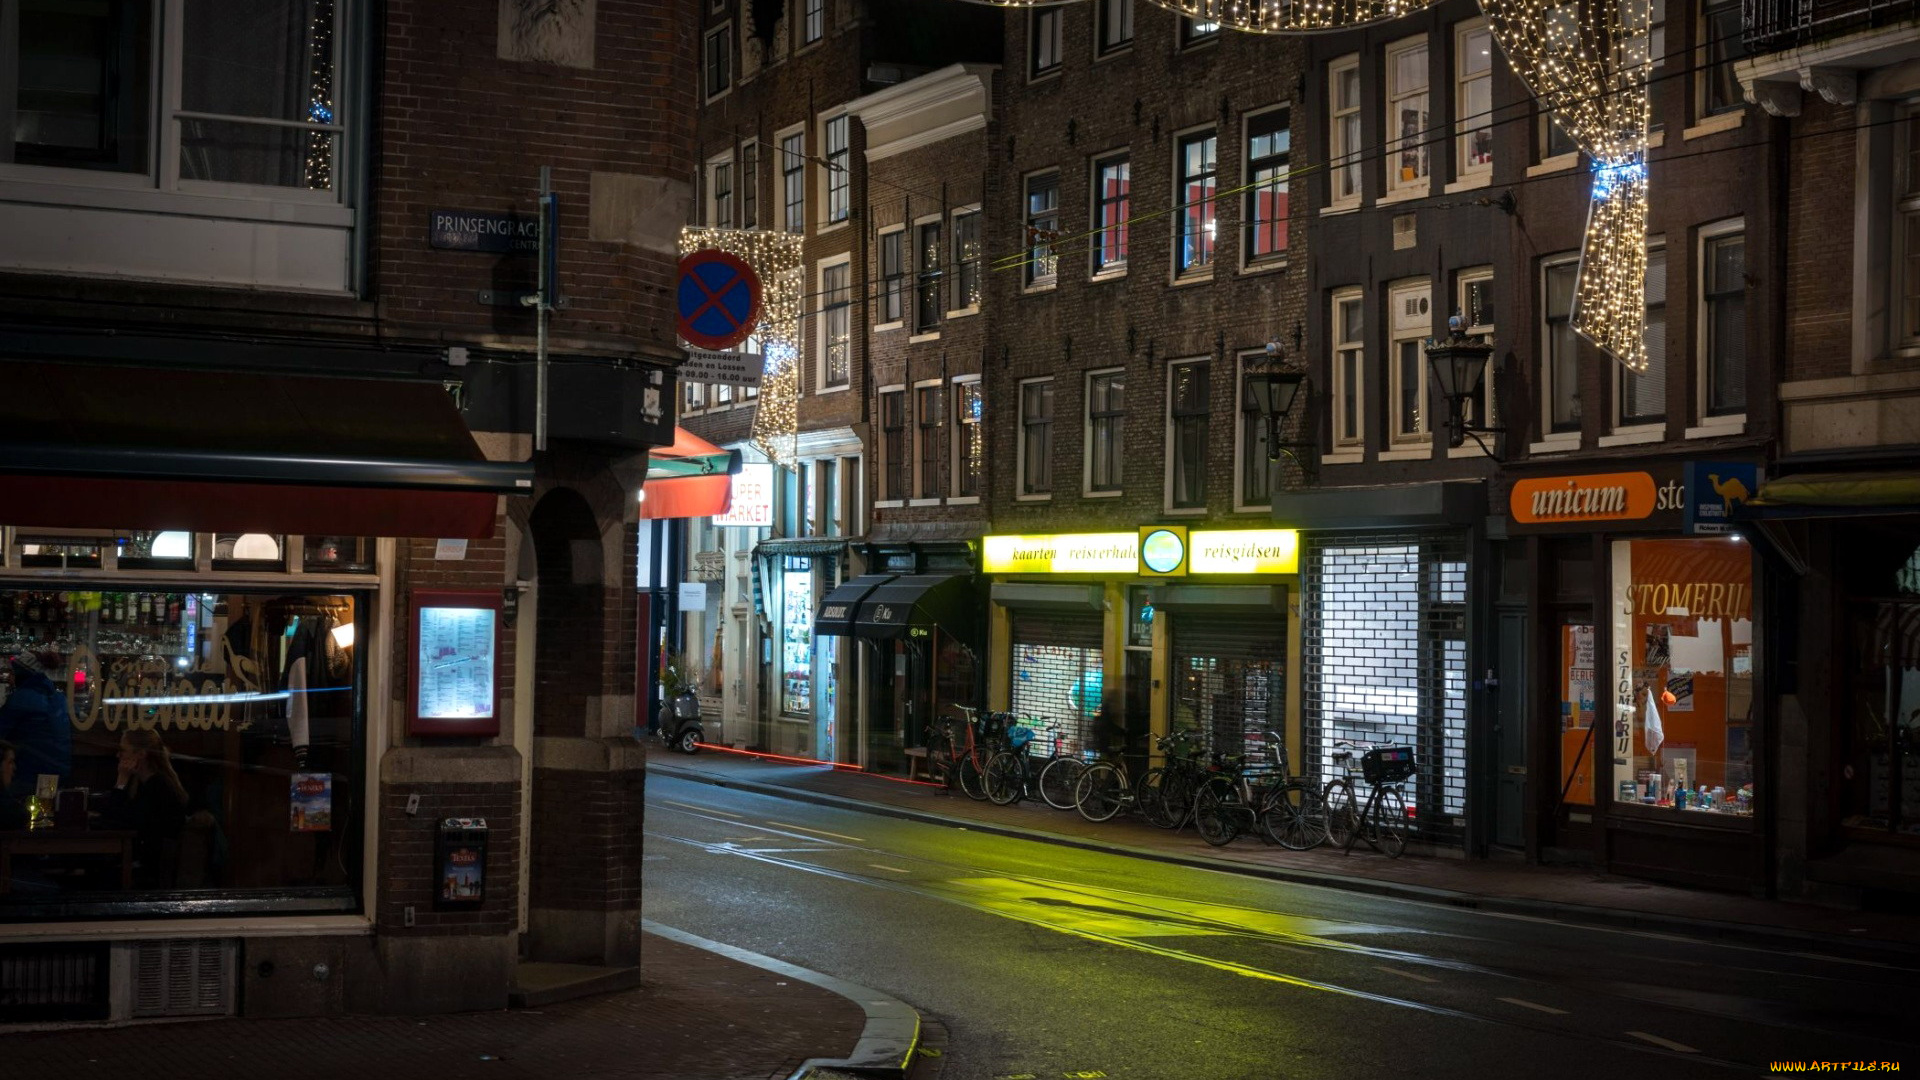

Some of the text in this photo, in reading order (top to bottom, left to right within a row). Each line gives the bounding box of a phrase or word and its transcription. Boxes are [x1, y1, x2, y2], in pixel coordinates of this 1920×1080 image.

[437, 215, 541, 238] PRINSENGRACH
[510, 239, 541, 251] CENTR
[690, 351, 741, 361] itgezonderd
[718, 373, 741, 381] 16.00
[743, 375, 757, 383] uur
[732, 483, 762, 500] UPER
[1531, 478, 1684, 516] unicum sto
[1012, 544, 1138, 561] kaarten reisverhale
[1204, 543, 1281, 563] reisgidsen
[1624, 583, 1745, 622] STOMERIJ
[1618, 651, 1632, 754] STOMERIJ
